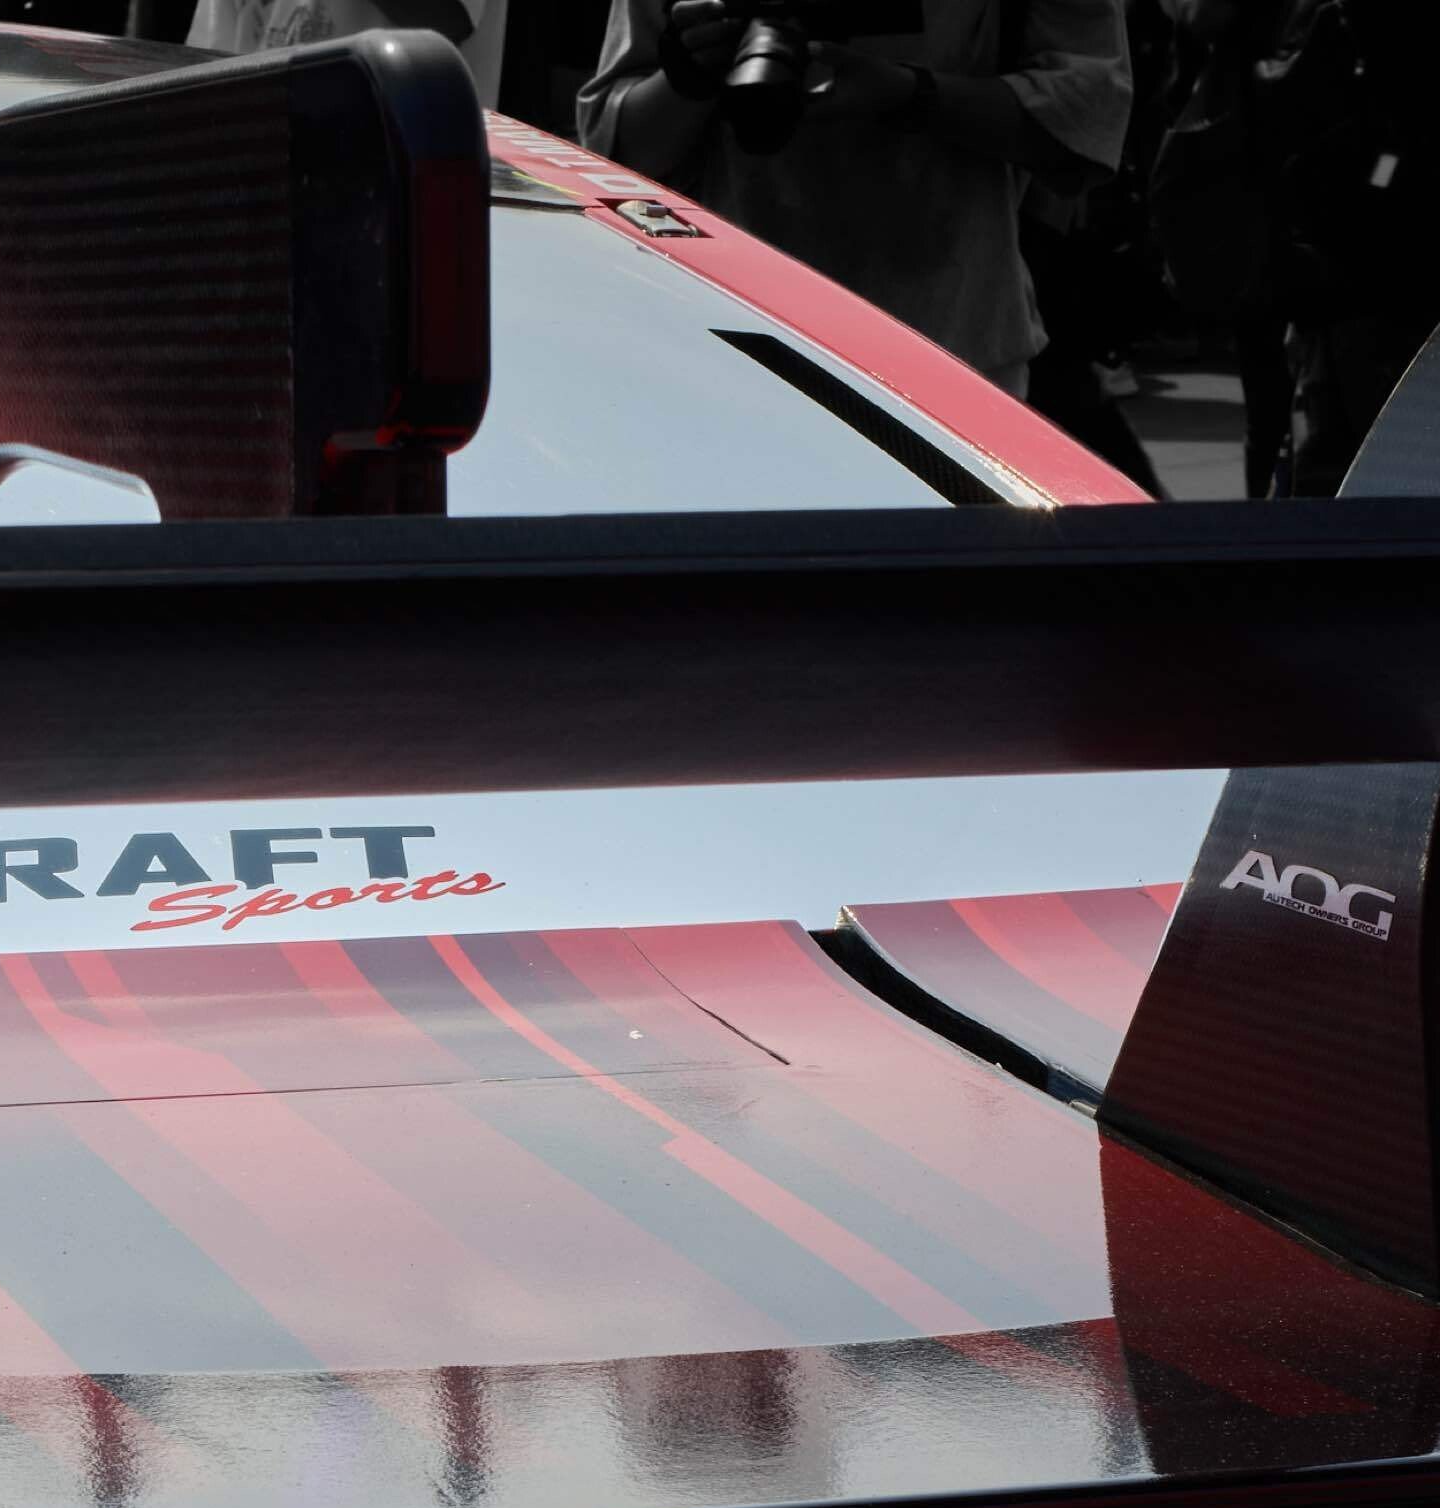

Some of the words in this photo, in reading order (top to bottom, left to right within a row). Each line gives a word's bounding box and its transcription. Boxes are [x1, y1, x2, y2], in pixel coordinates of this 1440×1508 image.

[130, 869, 507, 931] Sports
[1219, 850, 1397, 941] AOG
[1265, 891, 1305, 913] AUTECH
[1351, 919, 1388, 938] GROUP
